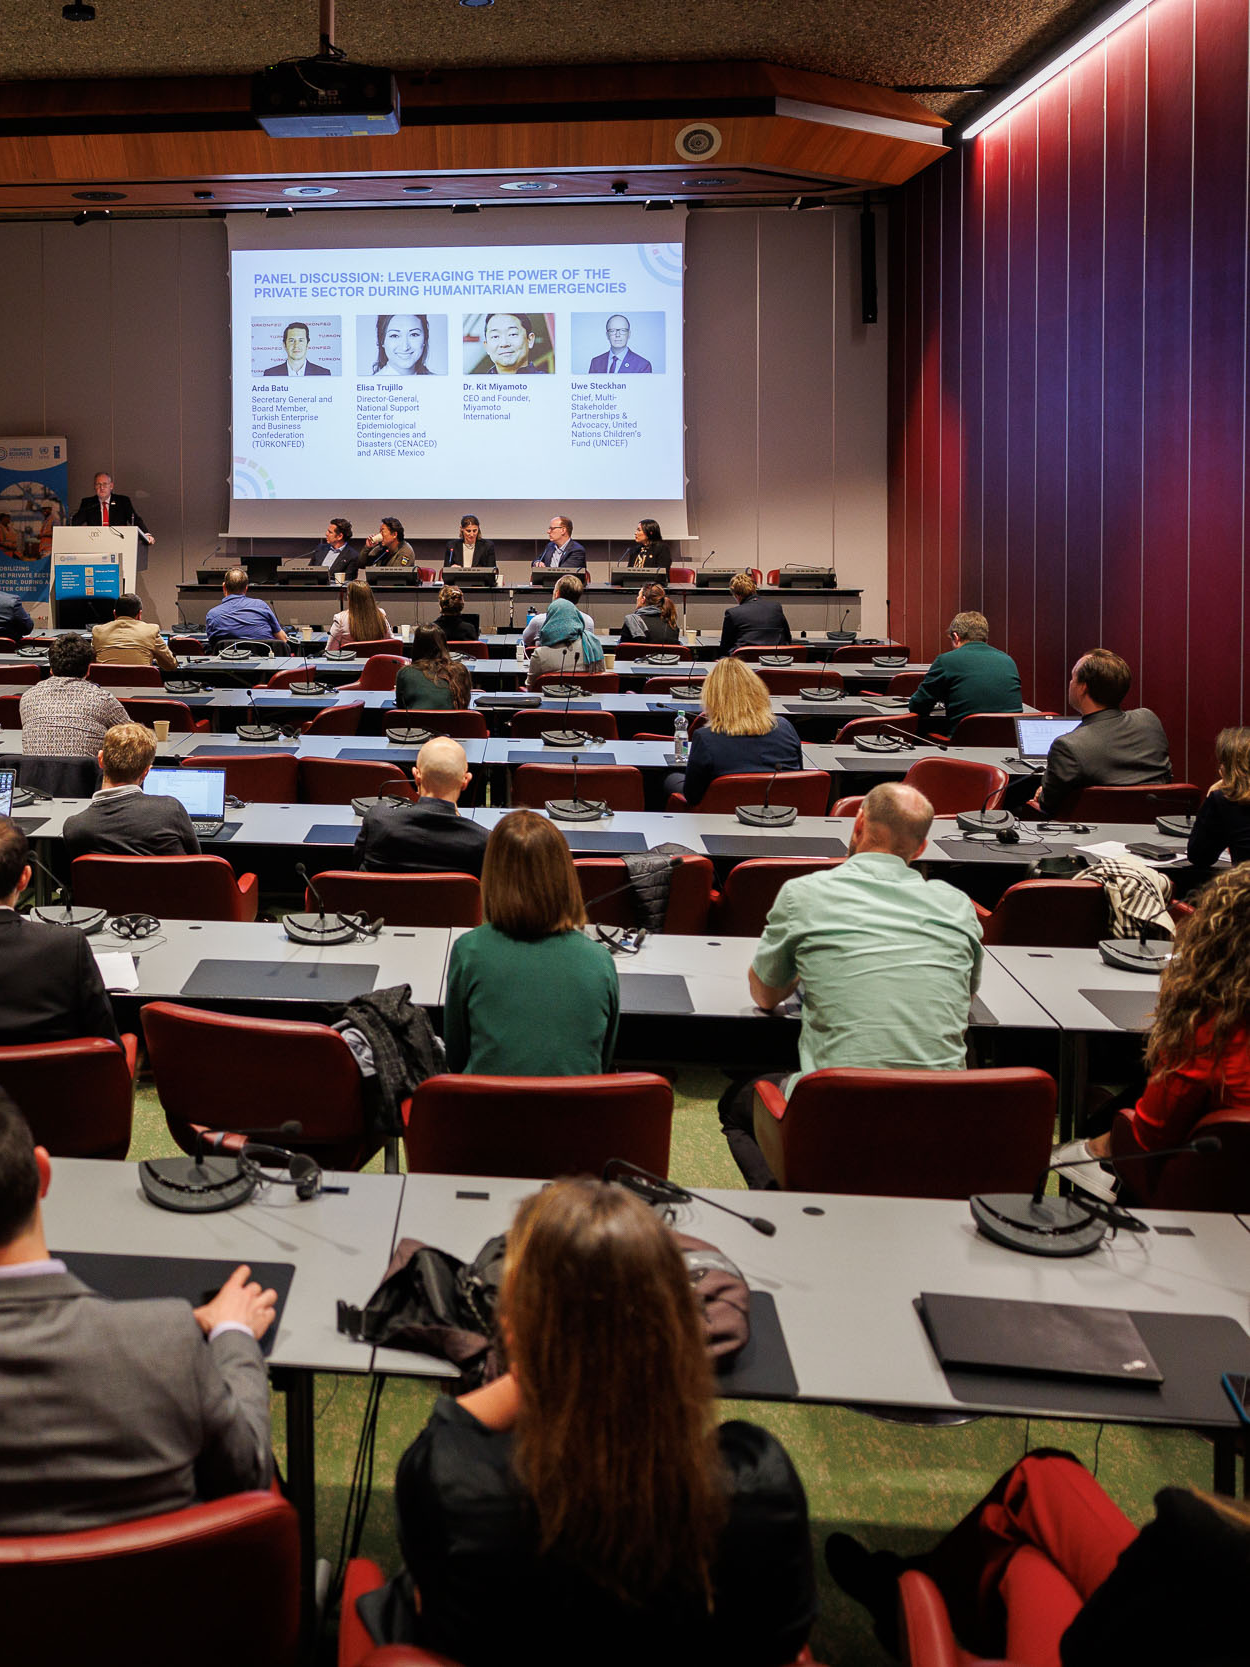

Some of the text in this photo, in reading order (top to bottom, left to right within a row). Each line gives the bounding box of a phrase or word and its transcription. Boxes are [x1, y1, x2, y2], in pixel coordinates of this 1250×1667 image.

[254, 268, 610, 284] PANEL DISCUSSION: LEVERAGING THE POWER OF THE
[254, 282, 627, 298] PRIVATE SECTOR DURING HUMANITARIAN EMERGENCIES
[251, 384, 289, 392] Arda Batu
[376, 383, 403, 393] Trujillo
[463, 383, 475, 391] Dr.
[489, 383, 528, 392] Miyamoto
[571, 382, 627, 390] Uwe Steckhan
[251, 396, 286, 405] Secretary
[288, 395, 317, 403] General
[356, 394, 419, 403] Director-General,
[463, 394, 531, 403] CEO and Founder,
[571, 393, 618, 402] Chief, Multi-
[275, 405, 308, 413] Member,
[356, 404, 420, 412] National Support
[463, 403, 501, 412] Miyamoto
[571, 403, 618, 411] Stakeholder
[252, 413, 319, 422] Turkish Enterprise
[356, 413, 394, 421] Center for
[463, 412, 511, 420] International
[571, 412, 628, 421] Partnerships &
[251, 422, 302, 430] and Business
[356, 421, 416, 431] Epidemiological
[571, 421, 638, 430] Advocacy, United
[251, 431, 305, 439] Confederation
[356, 431, 410, 440] Contingencies
[571, 430, 642, 438] Nations Children's
[252, 440, 305, 449] (TÜRKONFED)
[357, 439, 438, 448] Disasters (CENACED)
[571, 439, 628, 448] Fund (UNICEF)
[357, 449, 371, 457] and
[397, 449, 425, 457] Mexico
